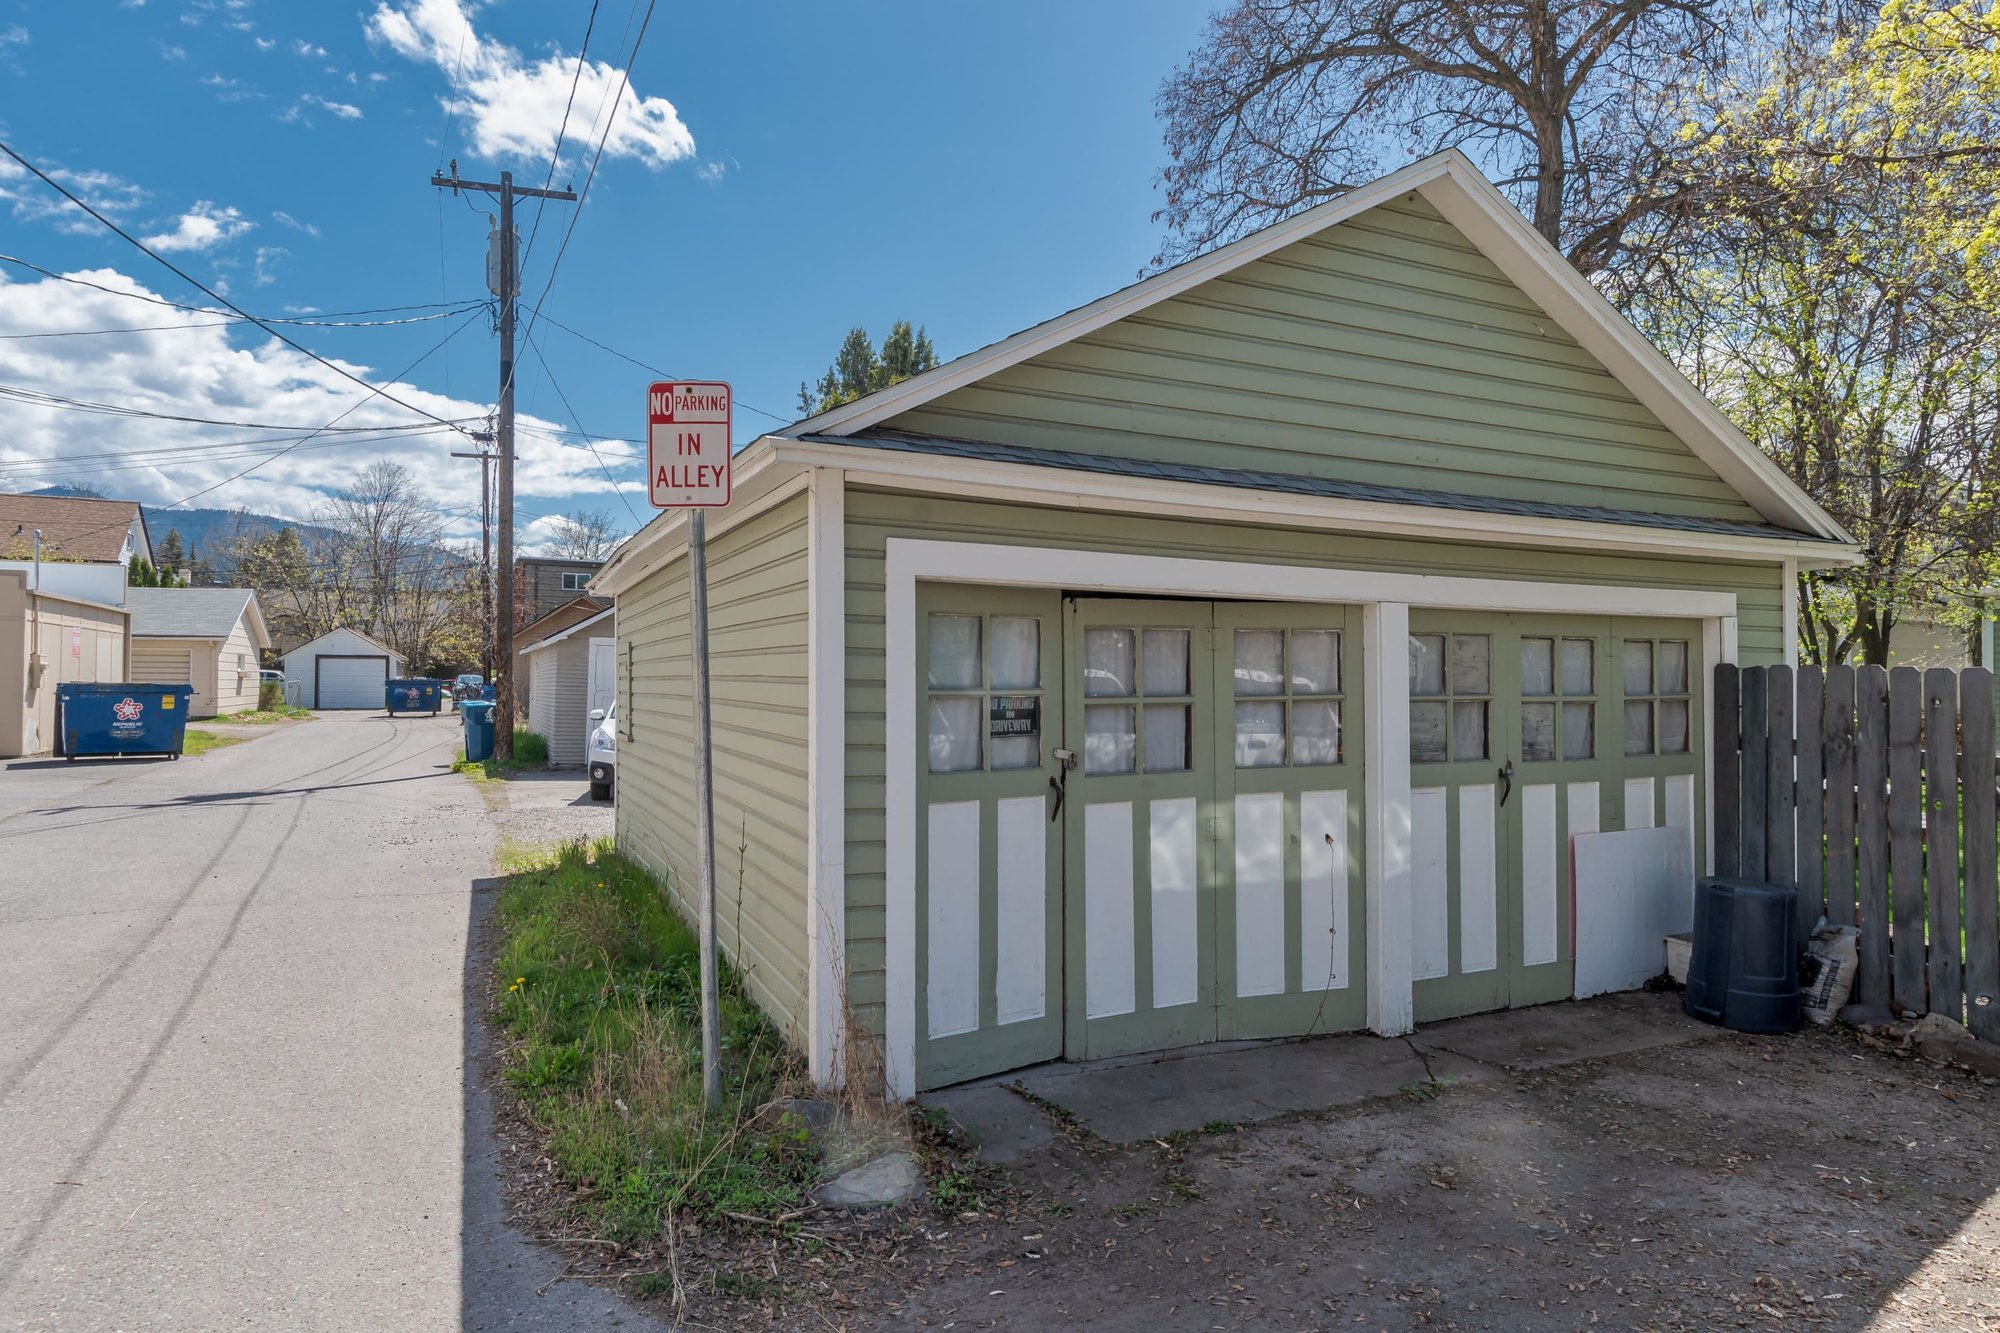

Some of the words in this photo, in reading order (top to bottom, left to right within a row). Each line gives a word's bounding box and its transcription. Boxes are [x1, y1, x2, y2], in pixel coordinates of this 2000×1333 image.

[650, 391, 673, 416] NO
[675, 395, 726, 411] PARKING
[678, 432, 701, 456] IN
[656, 465, 725, 488] ALLEY
[1000, 697, 1035, 710] PARKING
[1006, 710, 1015, 719] IN
[990, 719, 1031, 732] DRIVEWAY
